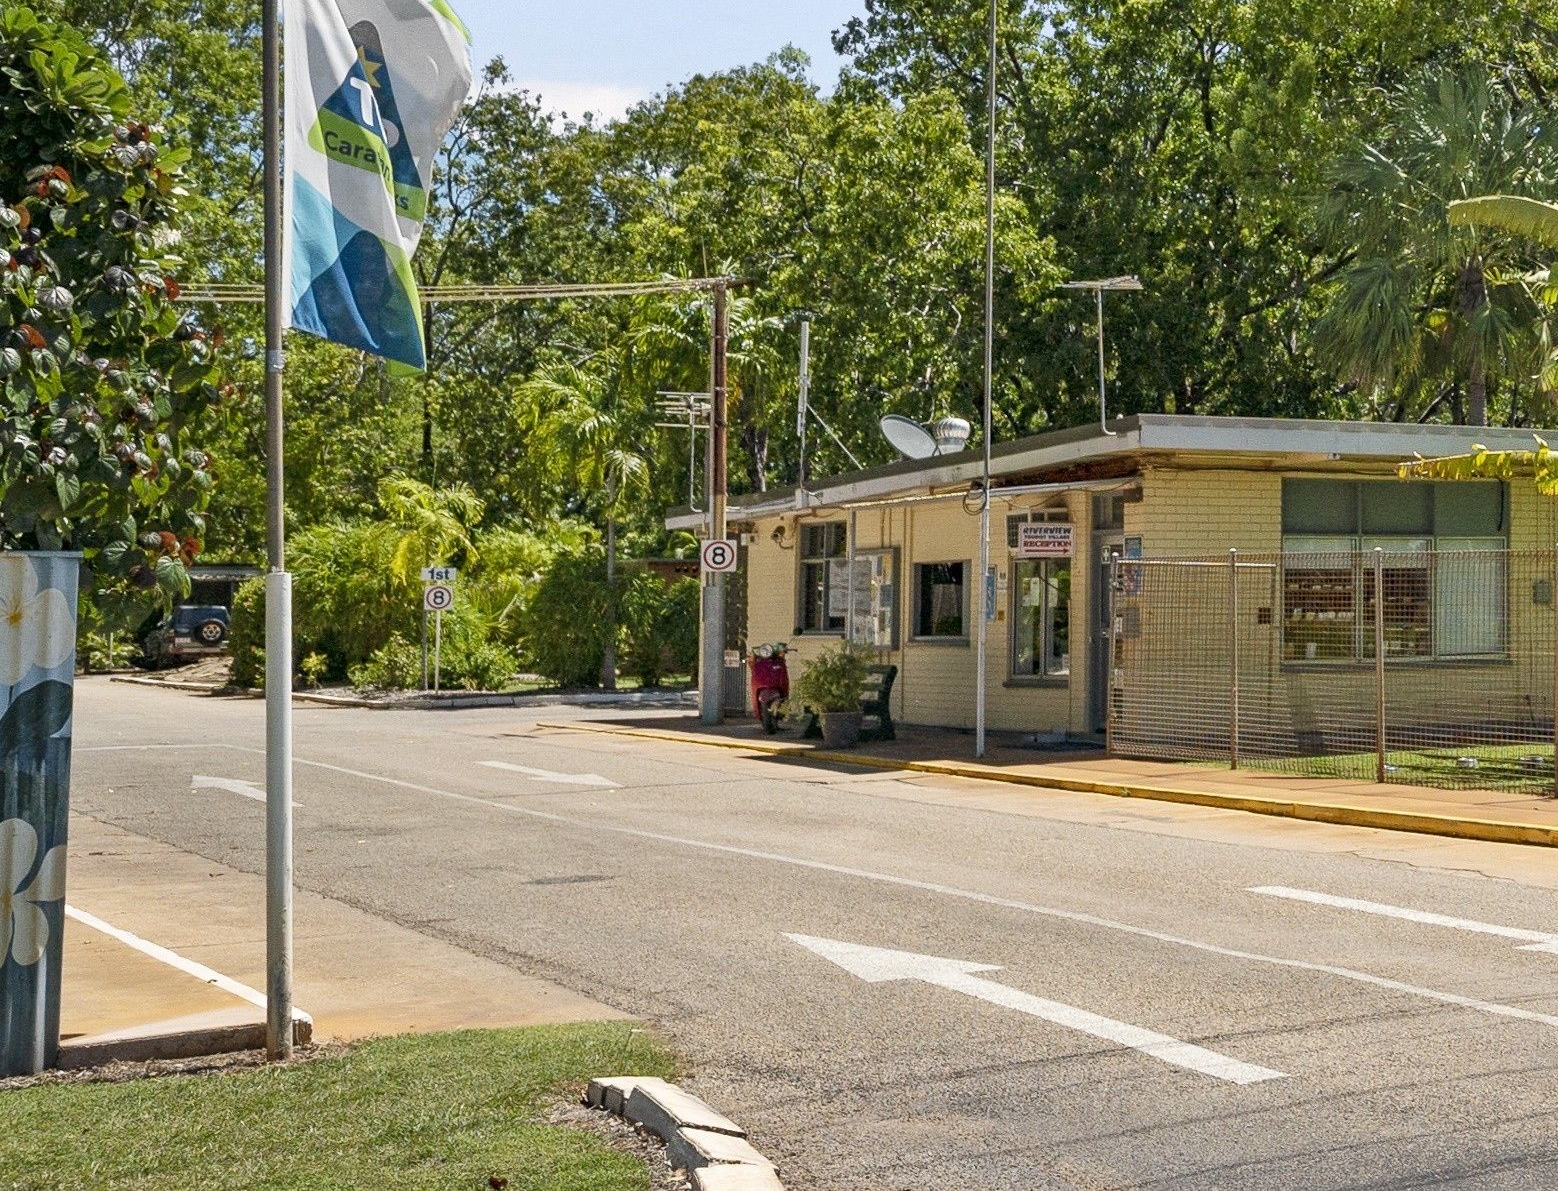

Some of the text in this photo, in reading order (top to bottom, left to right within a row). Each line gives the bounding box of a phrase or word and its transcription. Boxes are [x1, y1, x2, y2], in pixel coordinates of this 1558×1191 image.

[1022, 527, 1072, 535] RIVERVIEW
[1022, 540, 1072, 548] RECEPTION
[712, 546, 726, 565] 8
[428, 567, 450, 580] 1st
[433, 590, 445, 606] 8
